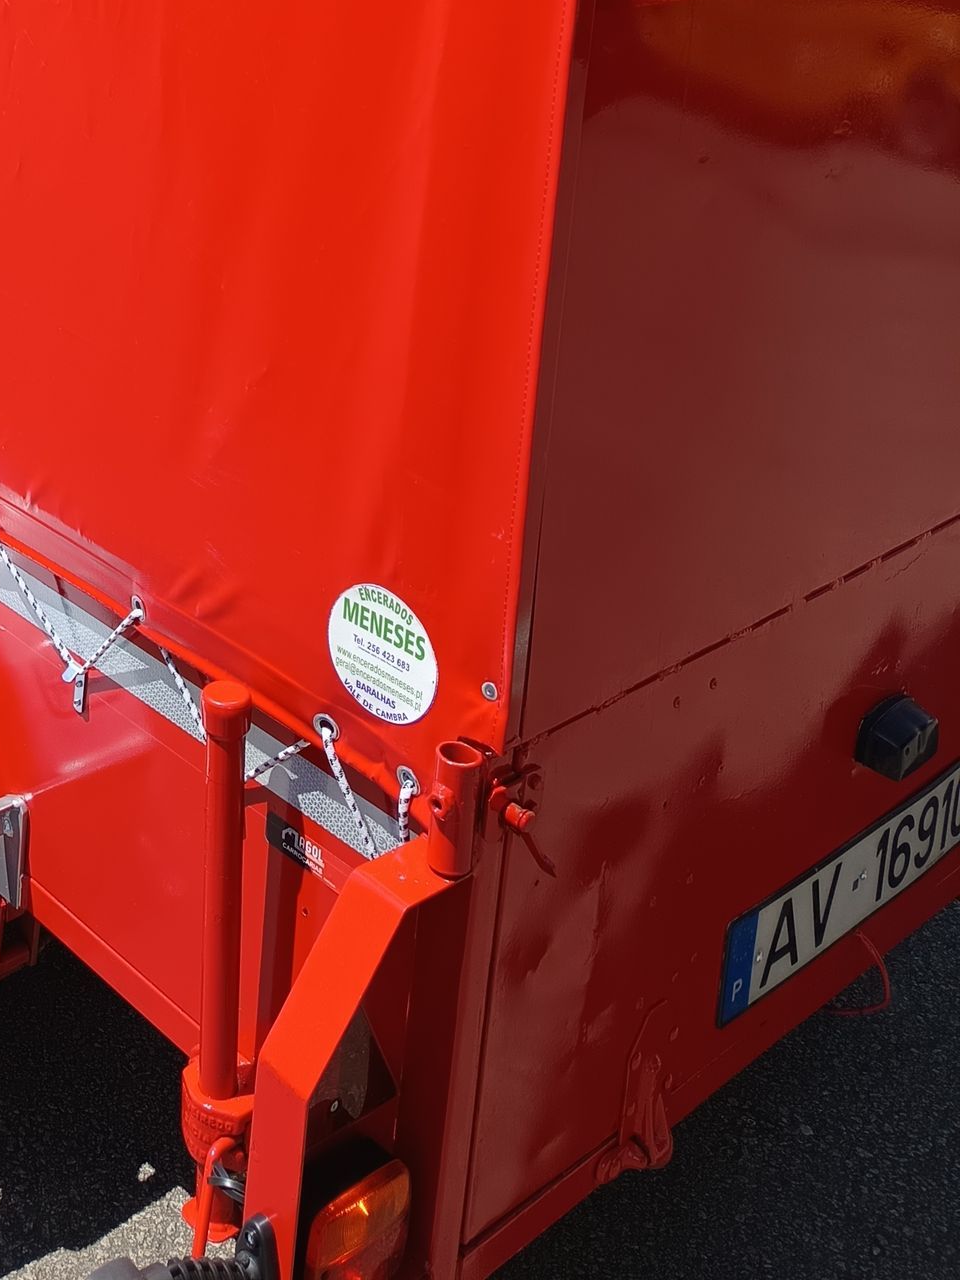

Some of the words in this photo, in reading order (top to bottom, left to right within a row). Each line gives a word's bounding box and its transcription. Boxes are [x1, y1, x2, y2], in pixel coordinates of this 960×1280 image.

[358, 586, 414, 626] ENCERADOS
[342, 596, 426, 661] MENESES
[336, 645, 423, 700] www.enceradosmeneses.pt
[353, 633, 365, 647] Tel.
[367, 641, 380, 655] 256
[382, 650, 395, 664] 423
[396, 658, 410, 672] 683
[335, 656, 421, 712] geral@enceradosmeneses.pt
[344, 678, 361, 701] VALE
[362, 699, 373, 711] DE
[375, 708, 409, 721] CAMBRA
[355, 679, 396, 709] BARALHAS
[731, 978, 743, 1003] P
